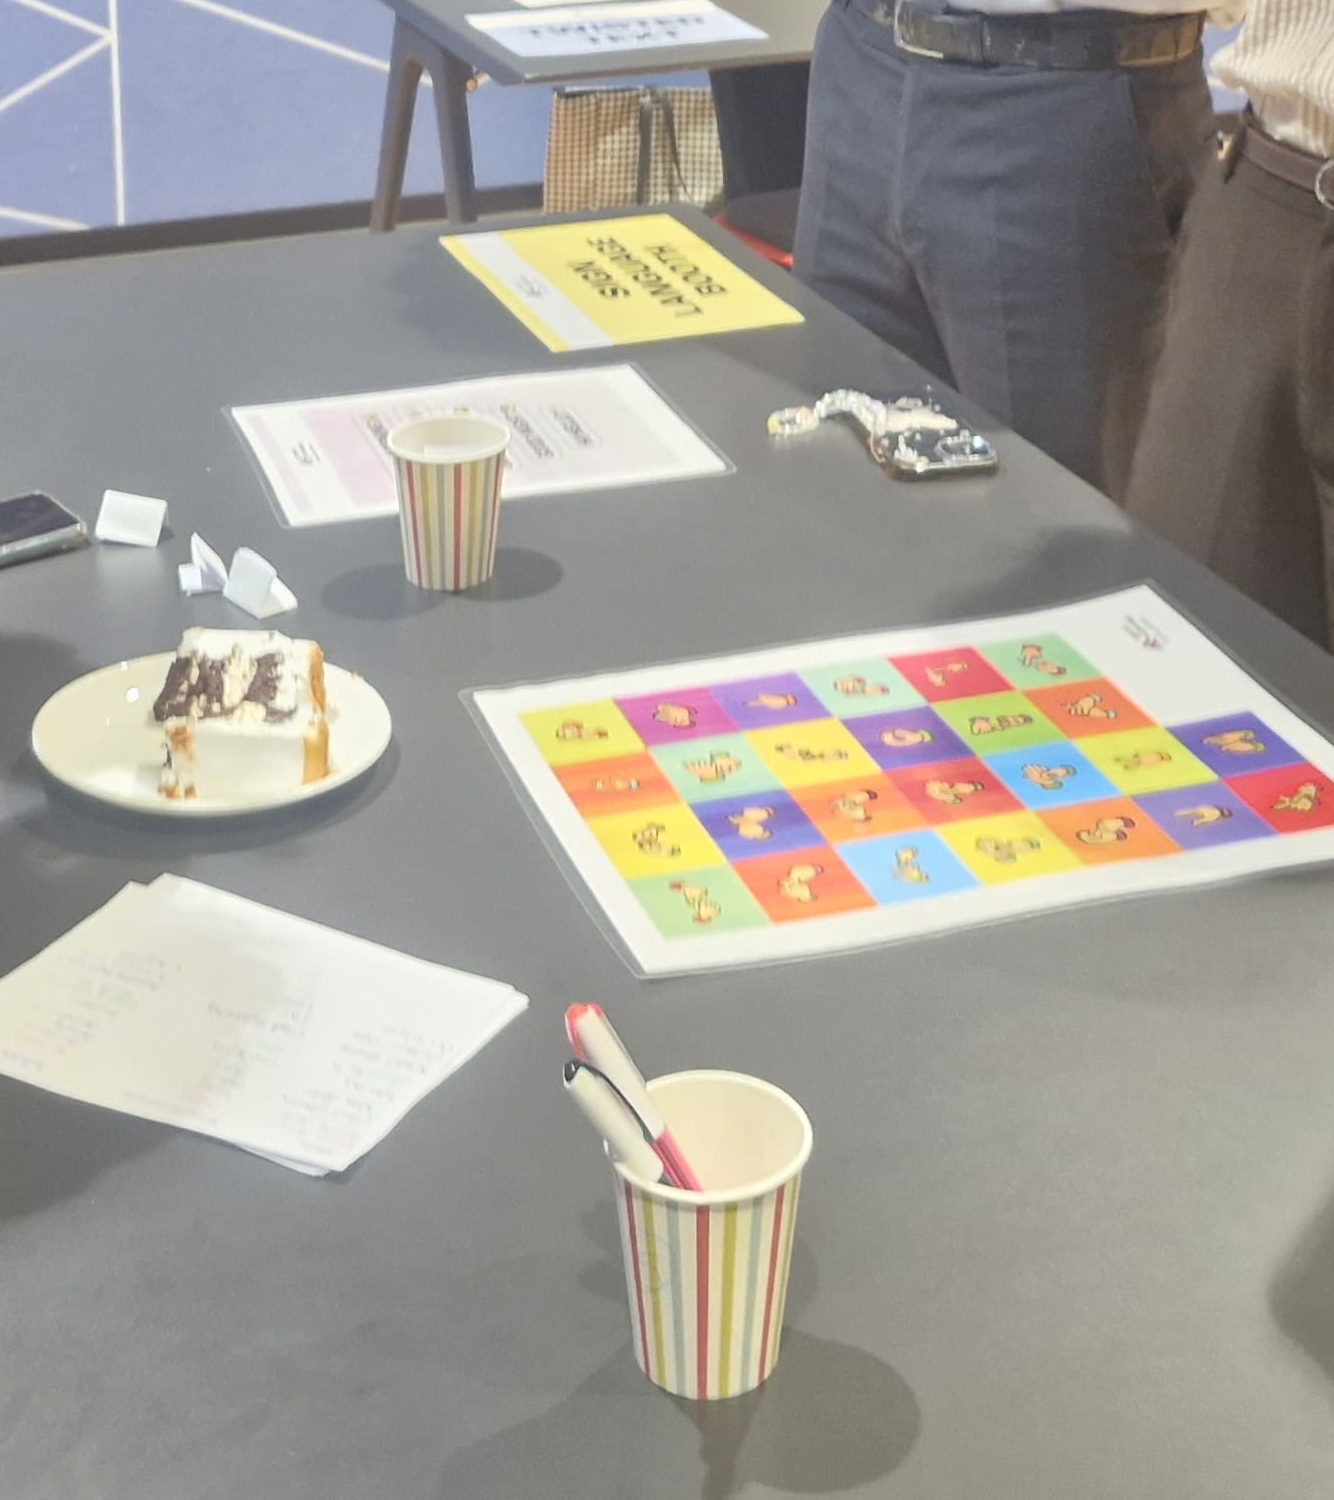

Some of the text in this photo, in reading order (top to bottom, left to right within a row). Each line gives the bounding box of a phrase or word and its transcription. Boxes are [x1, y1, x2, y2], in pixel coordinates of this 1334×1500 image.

[567, 259, 631, 298] SIGN
[587, 237, 704, 318] LANGUAGE
[644, 244, 729, 296] BOOTH
